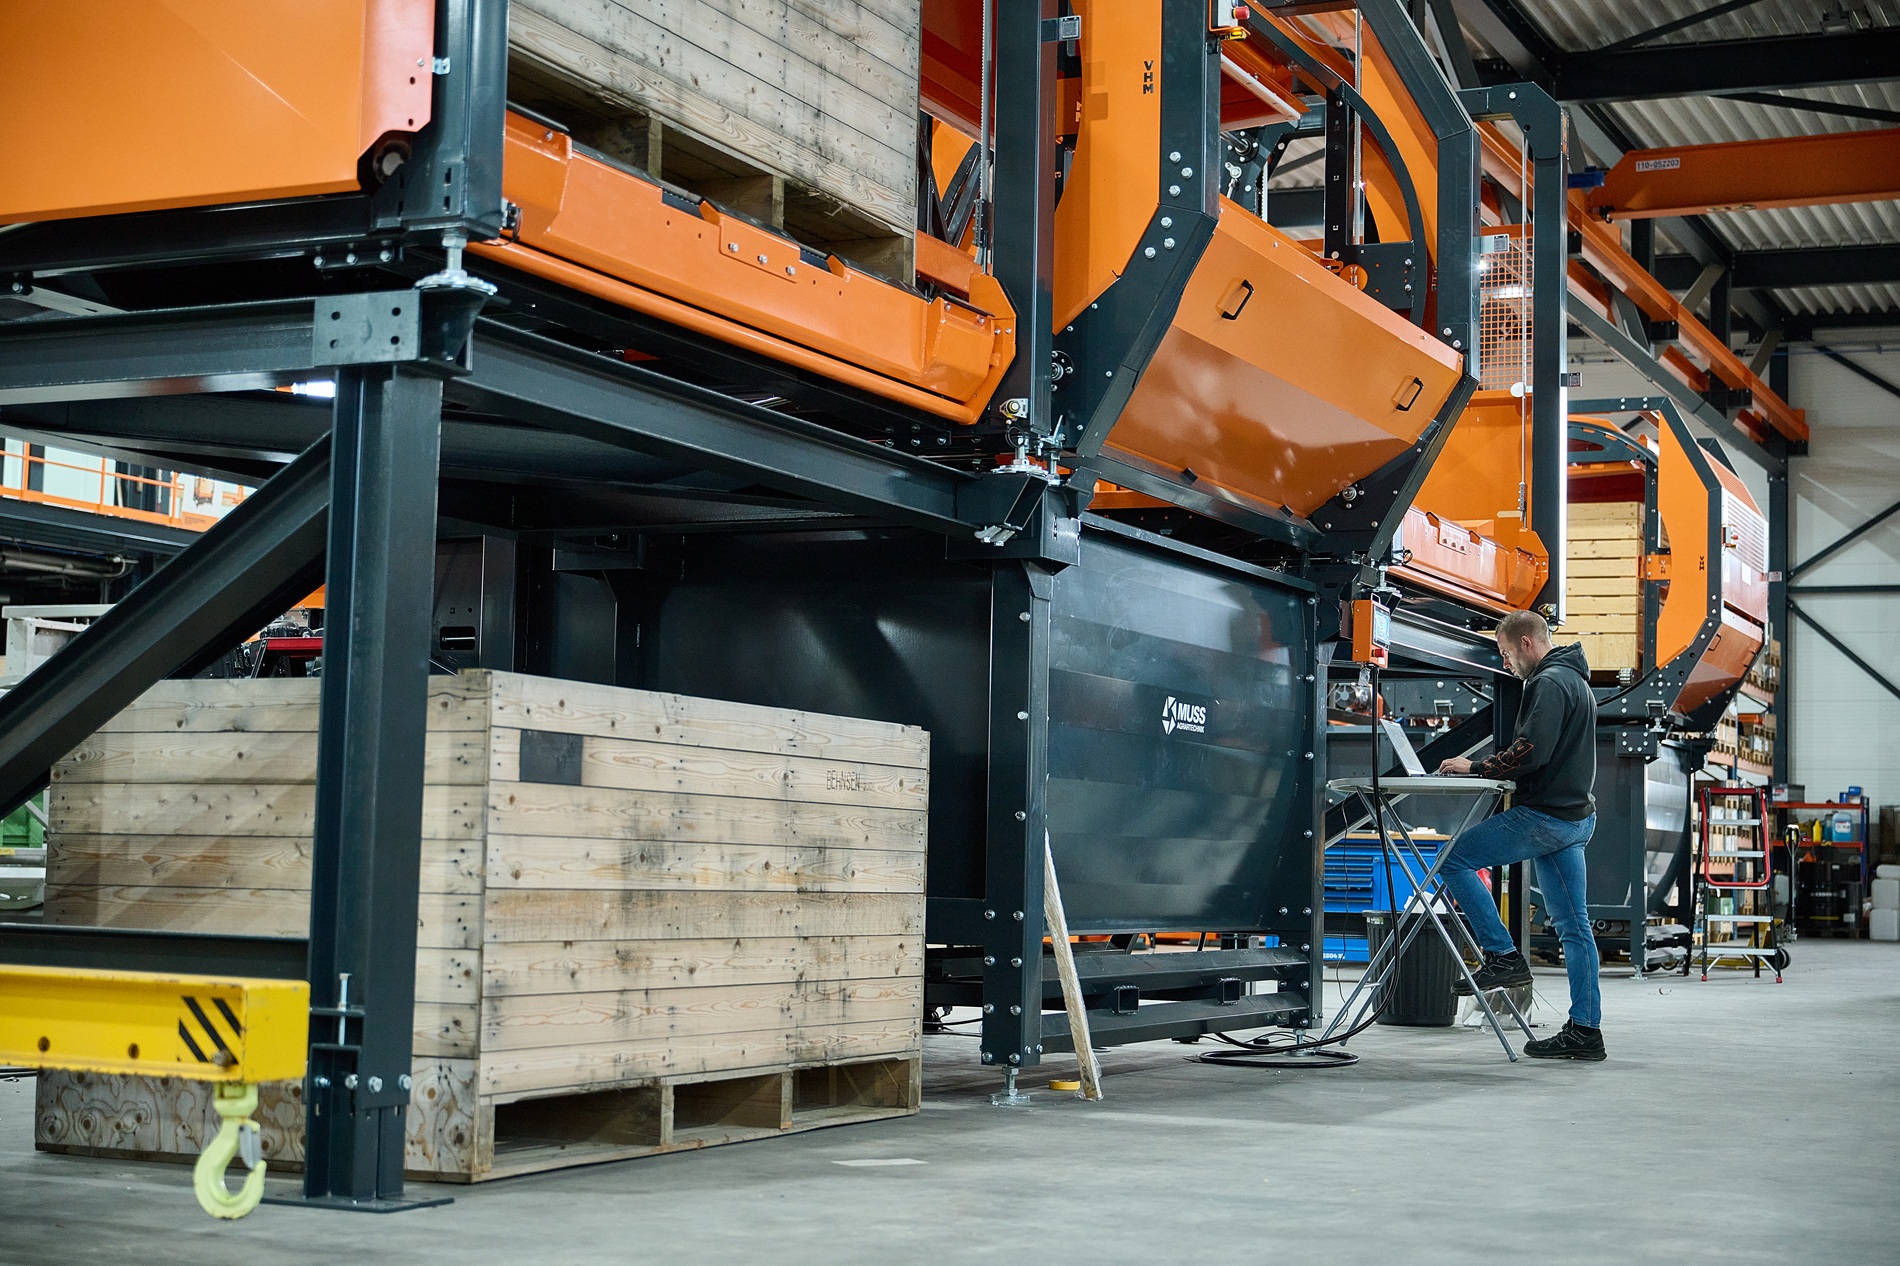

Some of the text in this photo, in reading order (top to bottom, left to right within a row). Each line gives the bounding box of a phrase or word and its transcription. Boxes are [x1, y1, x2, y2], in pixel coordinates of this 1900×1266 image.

[1143, 60, 1154, 94] VHM
[1177, 702, 1206, 725] MUSS
[826, 769, 861, 792] BEHNSEN
